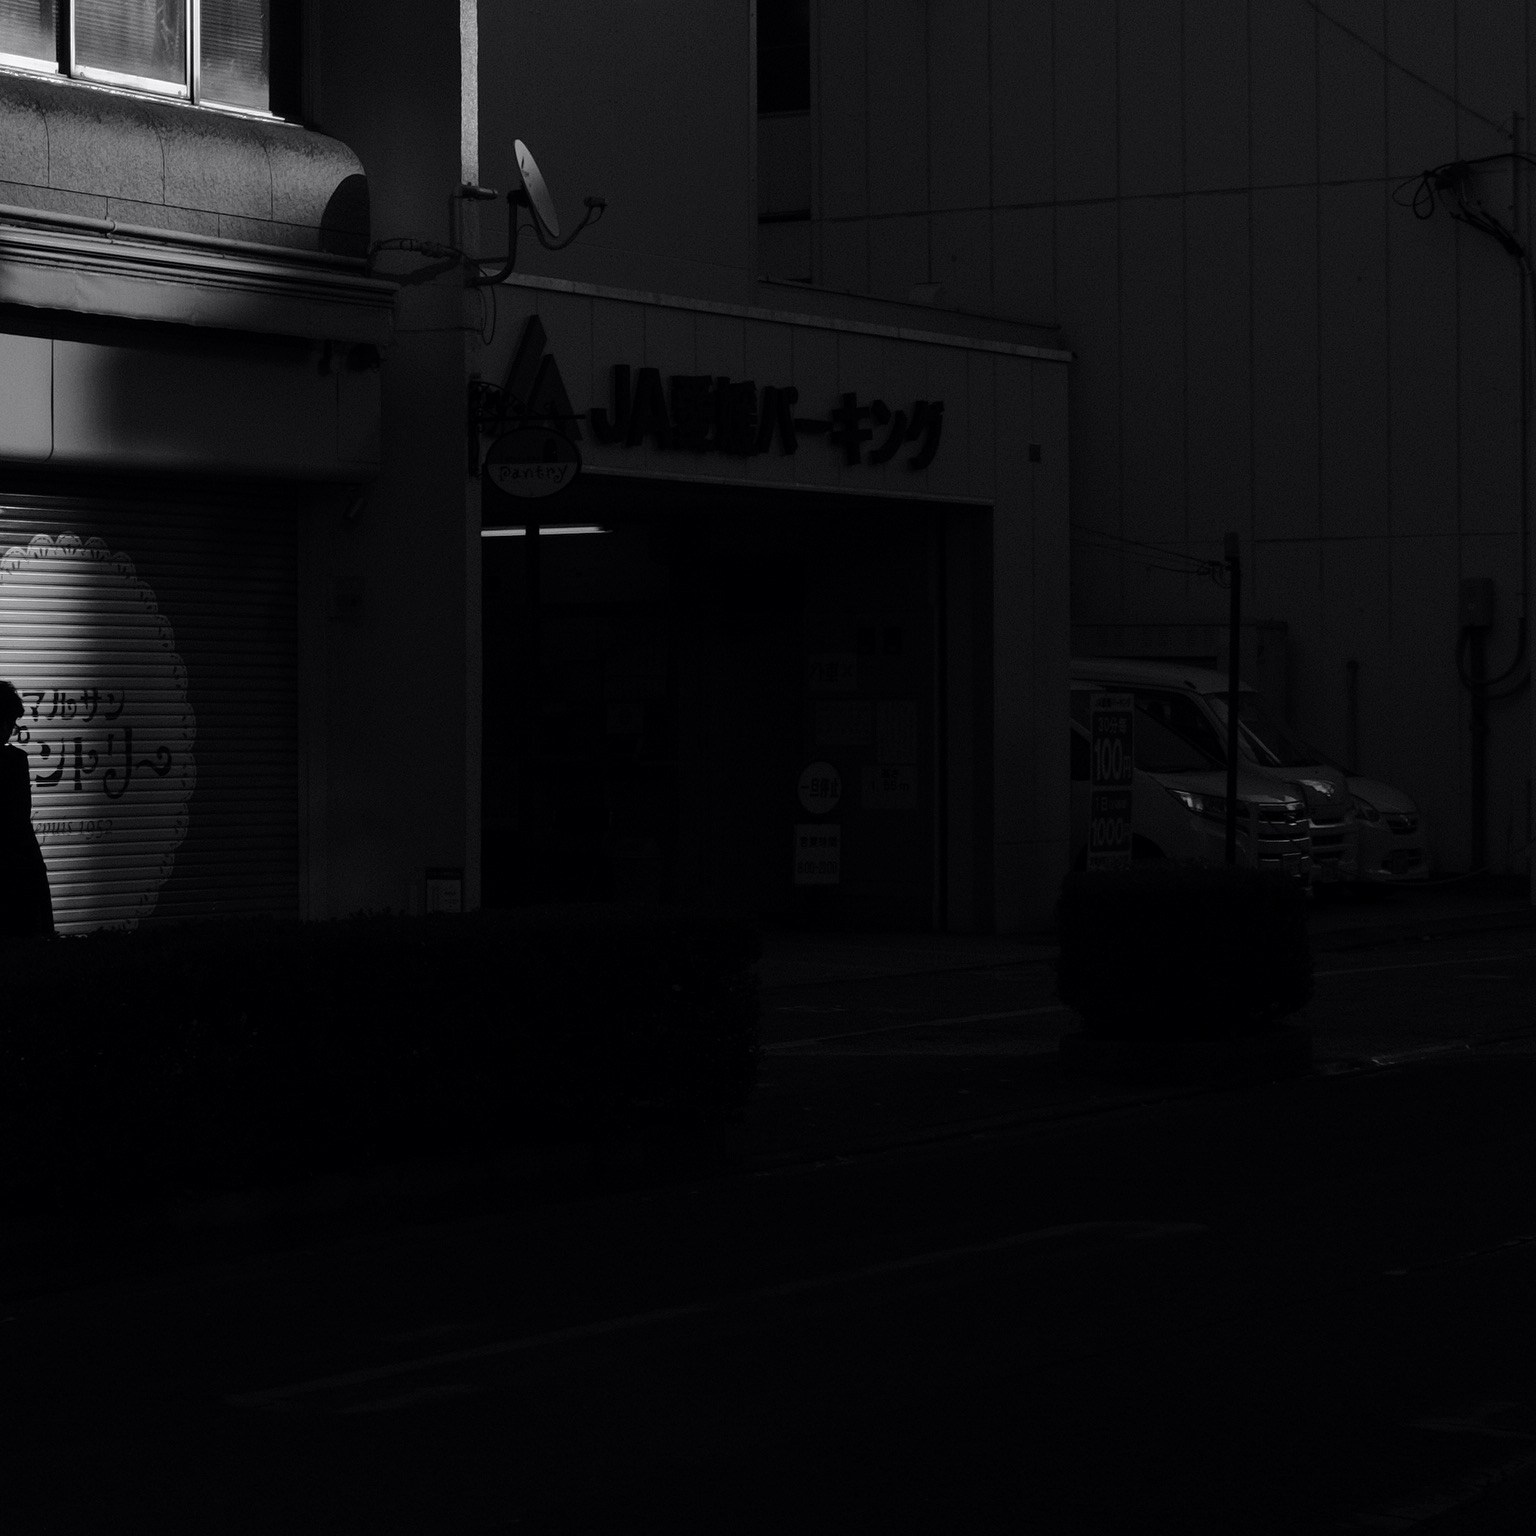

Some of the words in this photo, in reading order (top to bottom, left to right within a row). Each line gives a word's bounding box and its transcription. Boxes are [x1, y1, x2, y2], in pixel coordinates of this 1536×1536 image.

[22, 689, 125, 722] マルサン
[800, 777, 840, 798] 一旦停止
